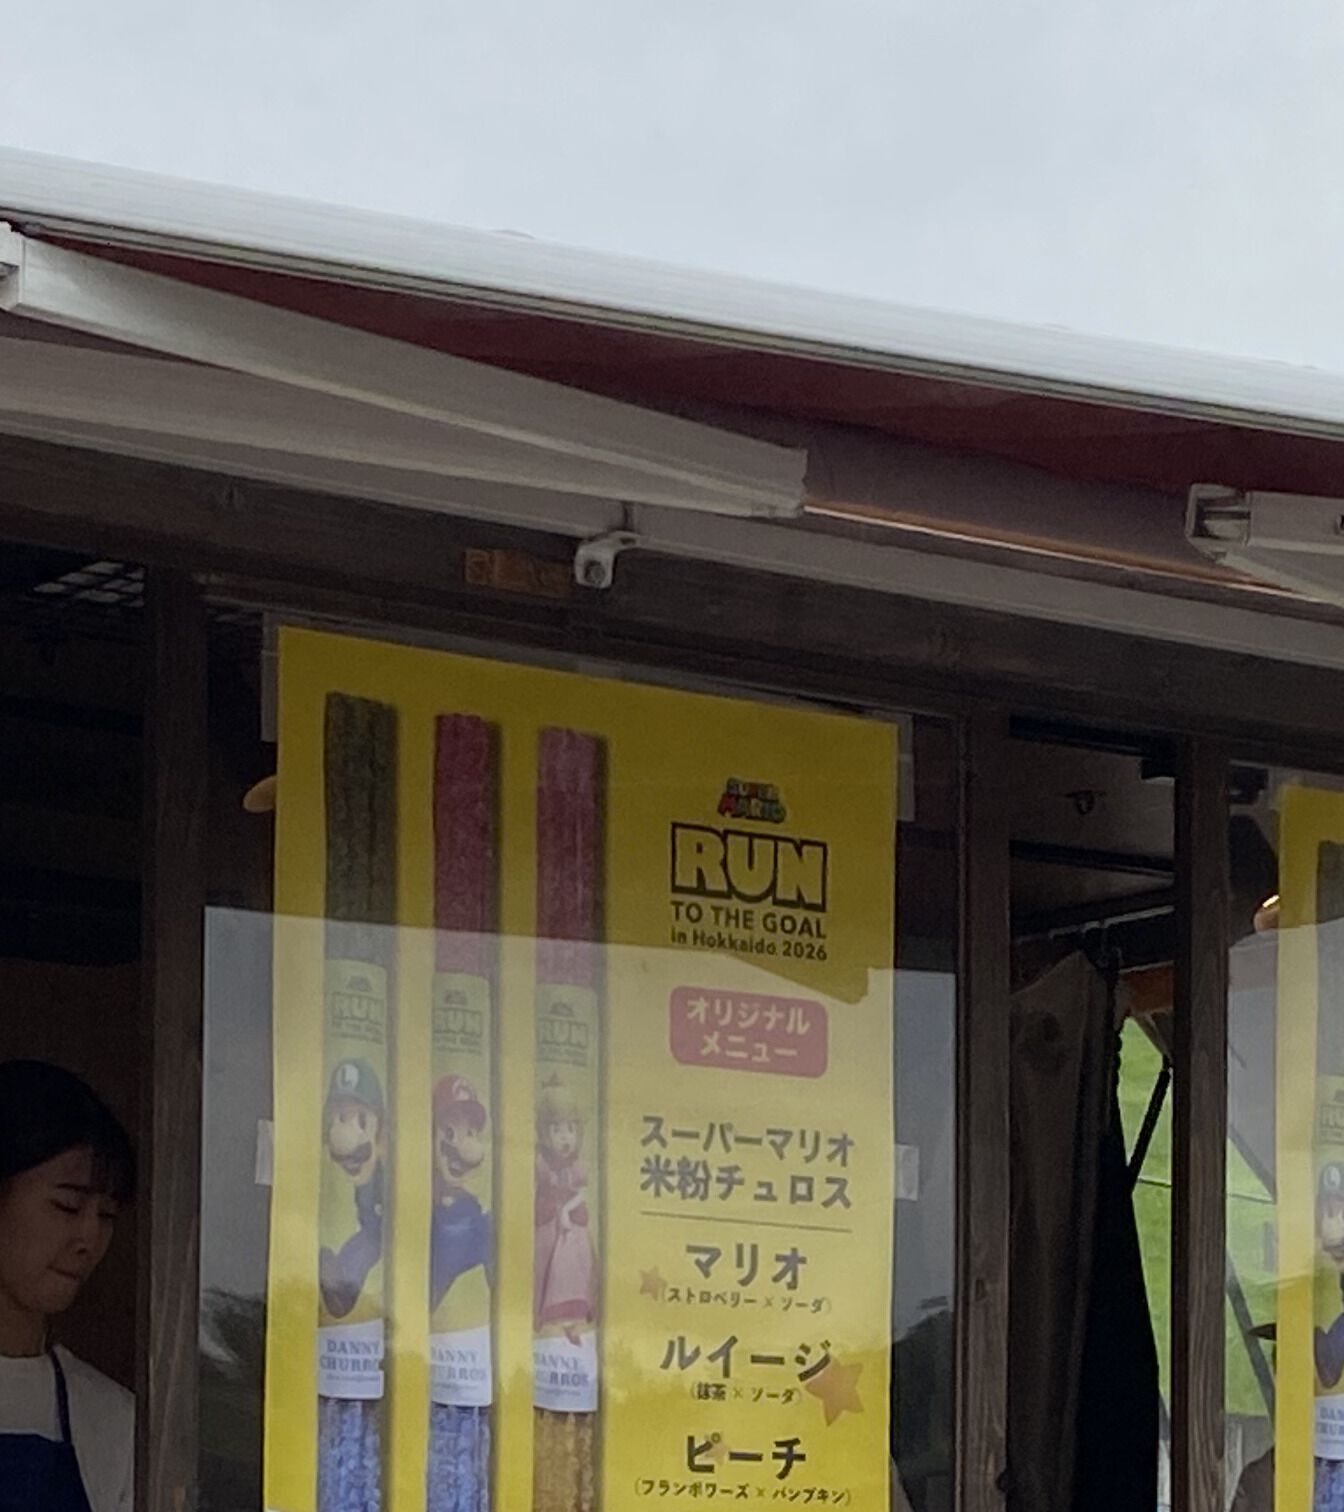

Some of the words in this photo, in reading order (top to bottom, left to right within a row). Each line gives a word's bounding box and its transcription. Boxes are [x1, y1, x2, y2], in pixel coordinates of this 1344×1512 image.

[671, 822, 828, 913] RUN
[671, 901, 703, 923] TO
[711, 905, 754, 929] THE
[762, 912, 827, 939] GOAL
[671, 927, 686, 944] in
[692, 932, 777, 955] Hokkaido
[782, 940, 827, 961] 2026
[687, 996, 810, 1035] オリジナル
[701, 1031, 798, 1062] メニュー
[640, 1115, 854, 1167] スーパーマリオ
[640, 1155, 852, 1209] 米粉チュロス
[686, 1243, 806, 1290] マリオ
[660, 1335, 831, 1382] ルイージ
[686, 1432, 806, 1480] ピーチ
